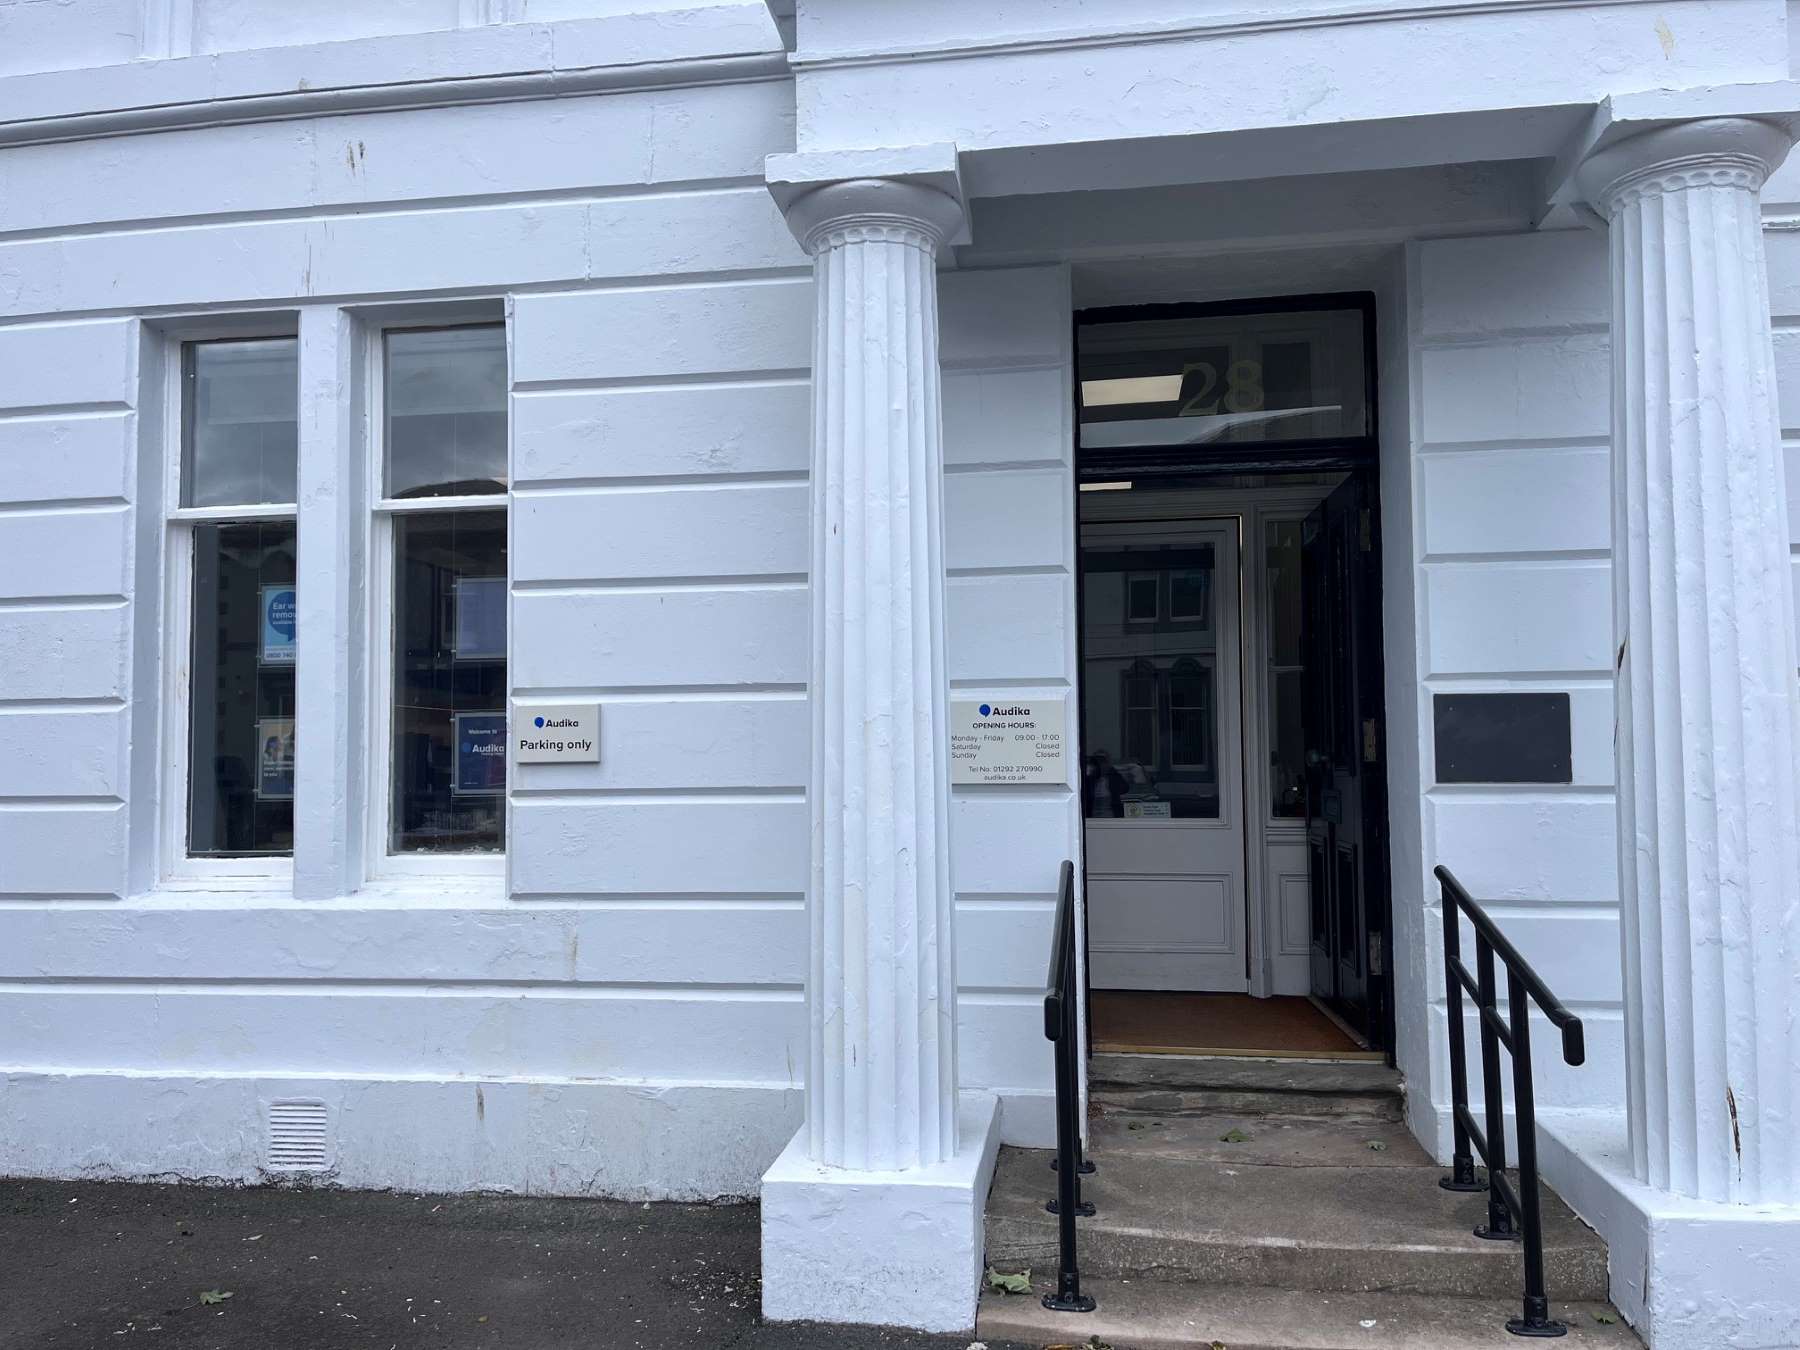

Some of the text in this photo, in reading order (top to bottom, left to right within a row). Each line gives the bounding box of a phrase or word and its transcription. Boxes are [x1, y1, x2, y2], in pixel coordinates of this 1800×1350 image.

[1179, 359, 1265, 417] 28
[273, 601, 285, 609] Ear
[992, 706, 1031, 716] Audika
[545, 718, 579, 728] Audika
[951, 735, 978, 743] Monday
[983, 735, 1004, 743] Friday
[472, 743, 504, 753] Audika
[520, 739, 592, 752] Parking only
[951, 743, 981, 751] Saturday
[951, 752, 977, 760] Sunday
